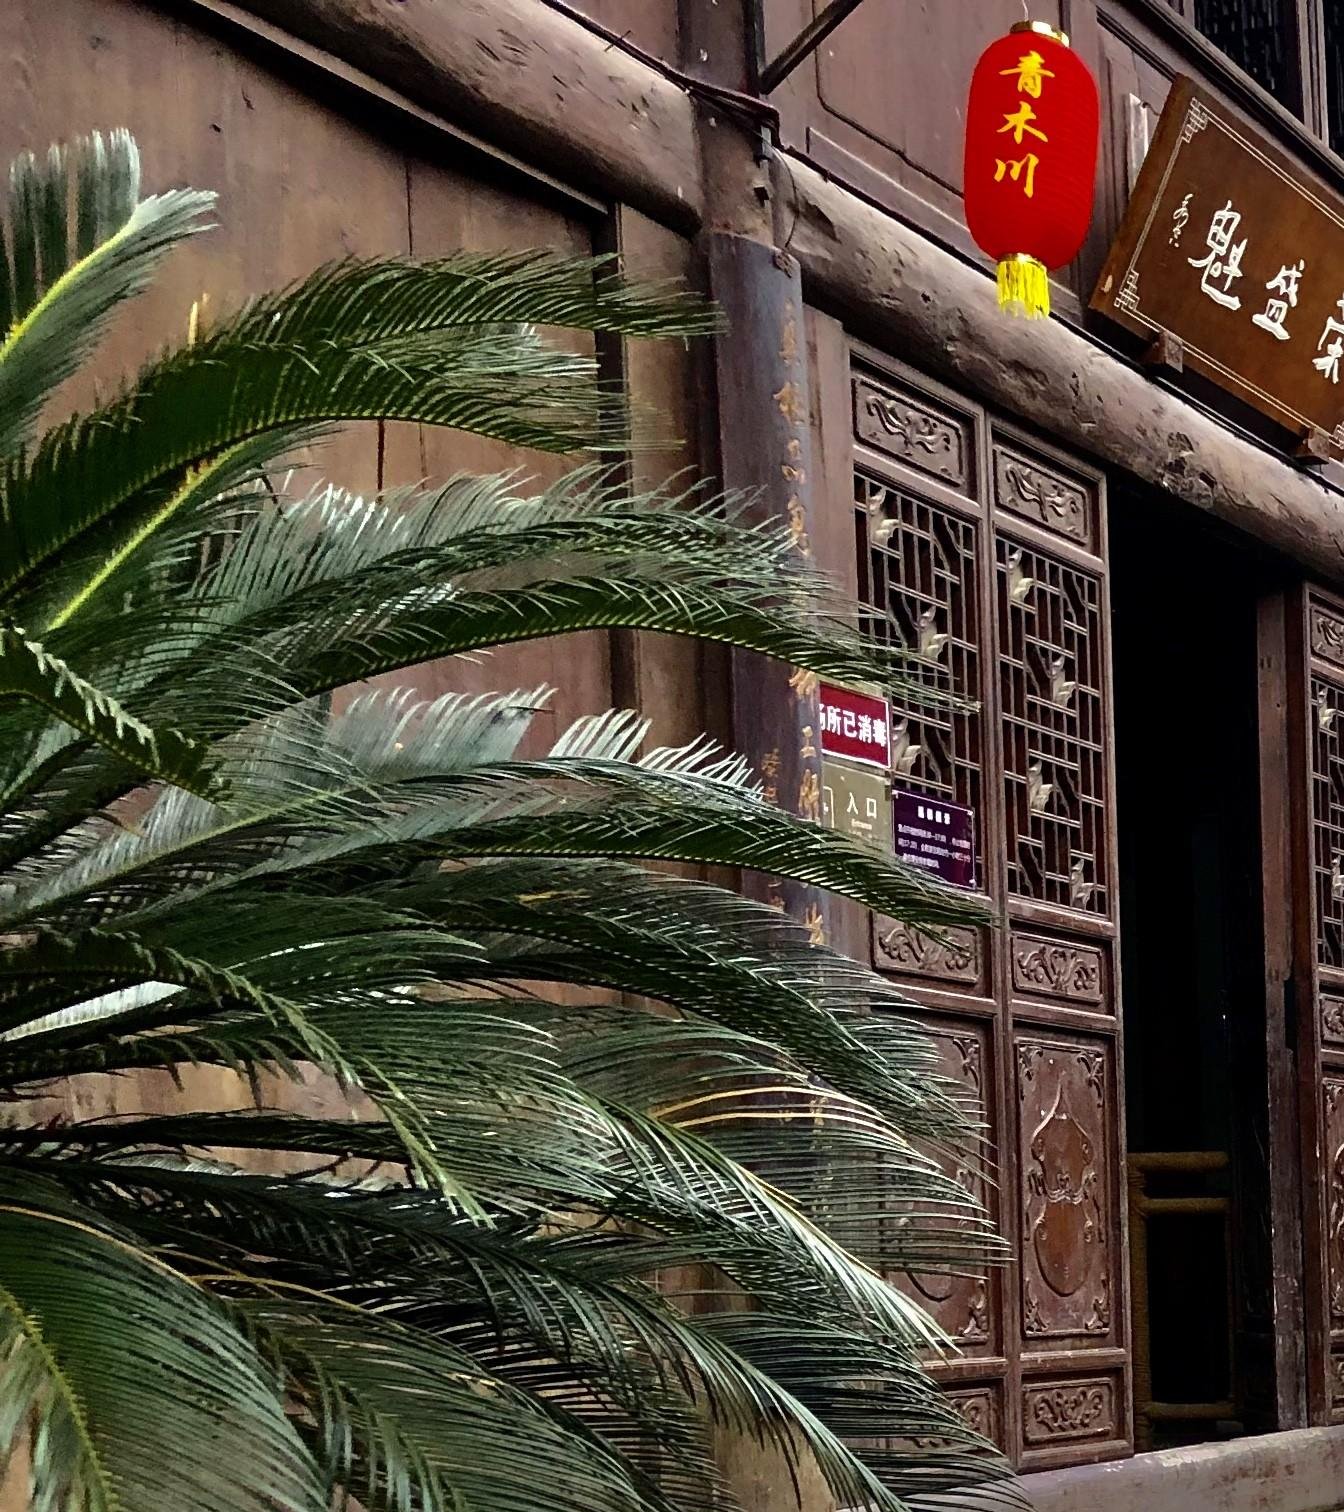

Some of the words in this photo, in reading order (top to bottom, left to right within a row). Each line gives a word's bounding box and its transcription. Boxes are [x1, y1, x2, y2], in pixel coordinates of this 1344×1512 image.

[993, 50, 1055, 199] 青木川
[847, 792, 877, 818] 入口
